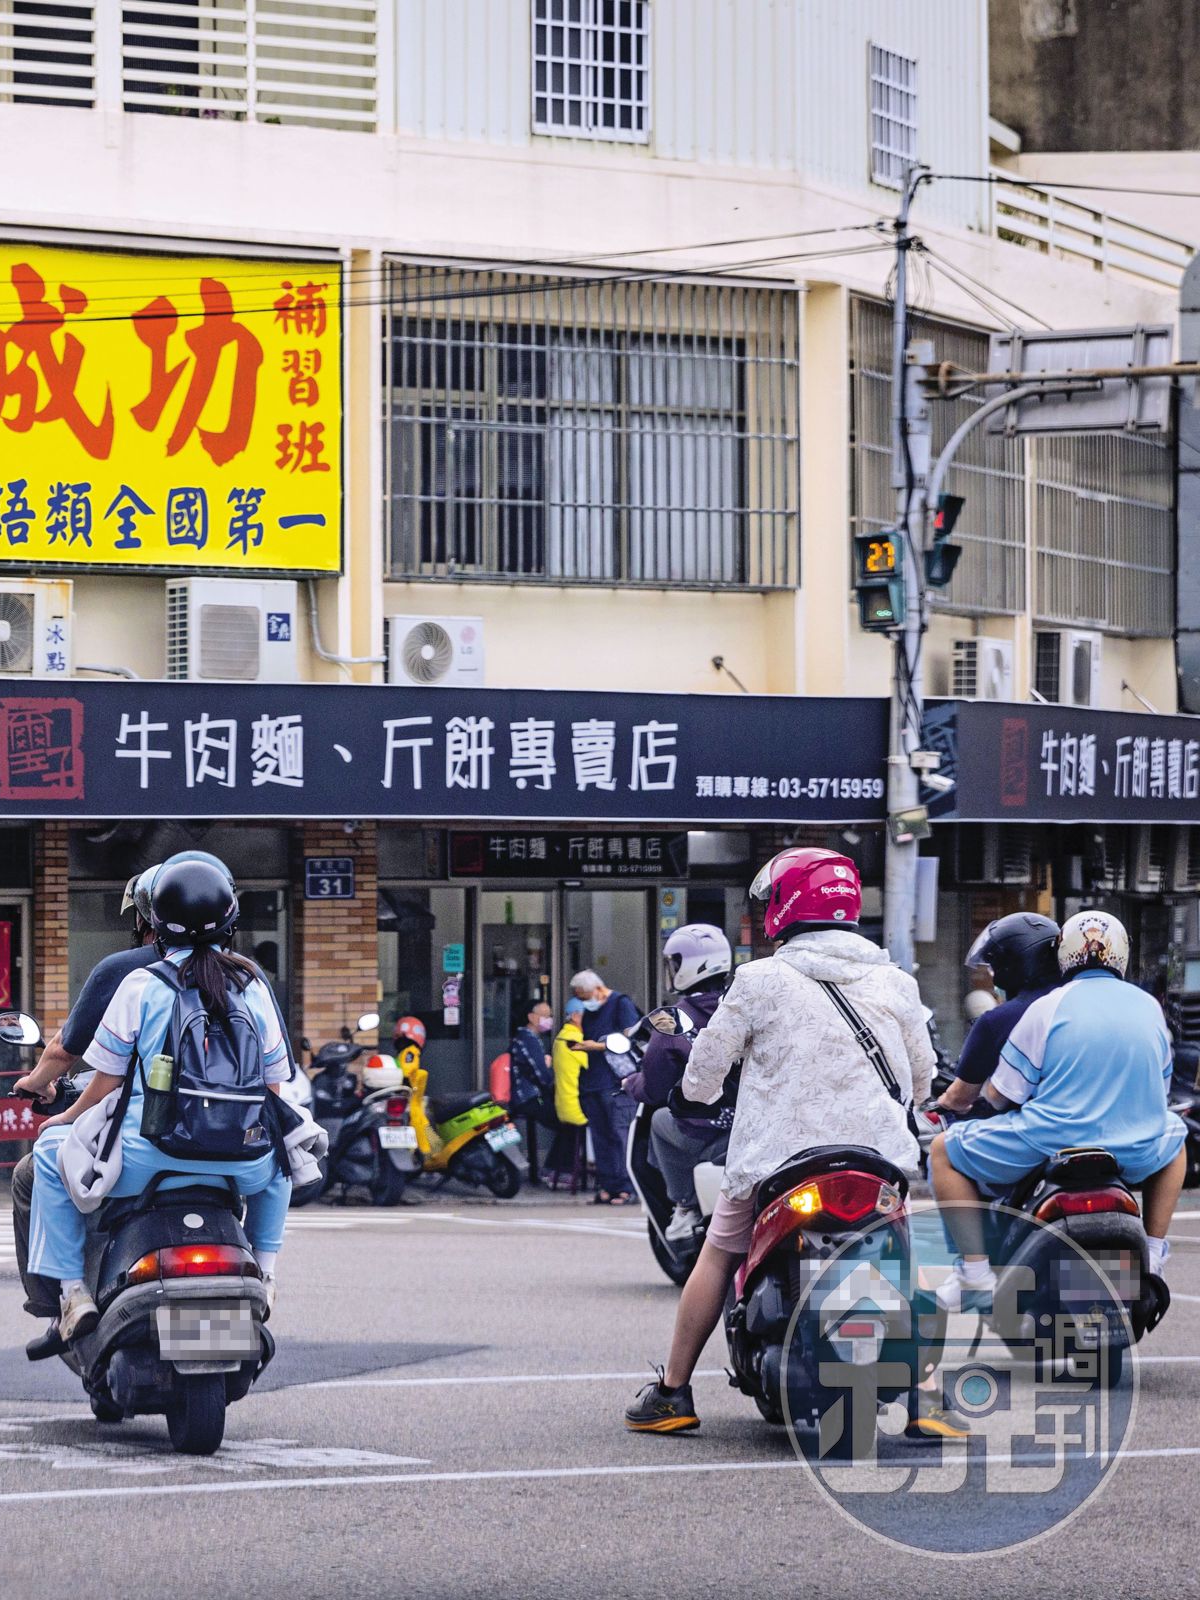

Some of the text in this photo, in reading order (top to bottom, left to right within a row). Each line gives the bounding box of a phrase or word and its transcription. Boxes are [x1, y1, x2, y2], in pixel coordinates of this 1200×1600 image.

[274, 279, 331, 475] 補習班
[866, 541, 896, 572] 27
[114, 709, 679, 793] 牛肉麵、斤餅專賣店
[318, 878, 343, 895] 31
